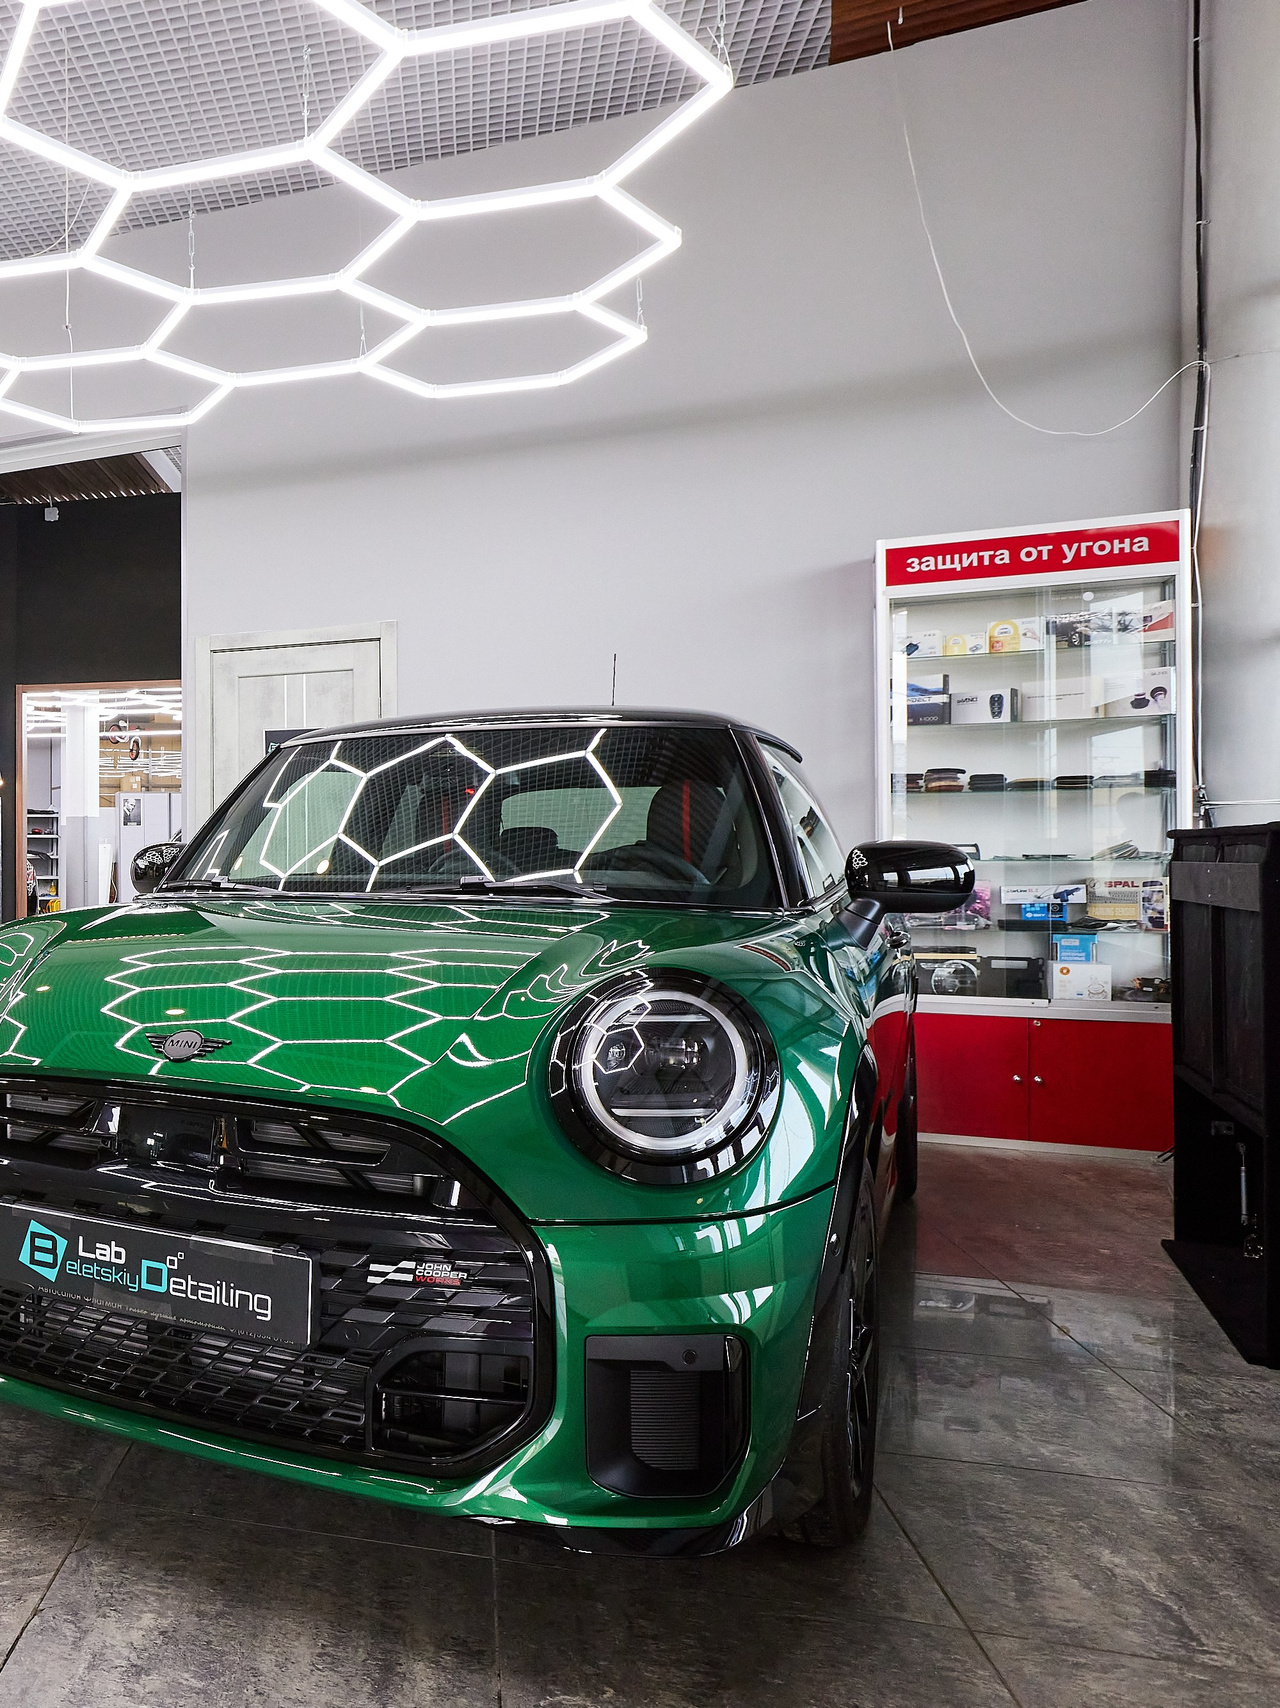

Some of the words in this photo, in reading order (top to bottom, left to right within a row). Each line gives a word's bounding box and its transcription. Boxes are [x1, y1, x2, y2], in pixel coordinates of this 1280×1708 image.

[906, 550, 1010, 573] защита
[1020, 545, 1053, 562] от
[1061, 536, 1149, 564] угона
[168, 1039, 198, 1049] MINI
[78, 1235, 126, 1265] Lab
[416, 1262, 452, 1272] JOHN
[415, 1269, 468, 1280] COOPER
[415, 1275, 462, 1286] WORKS
[140, 1259, 272, 1321] Detailing
